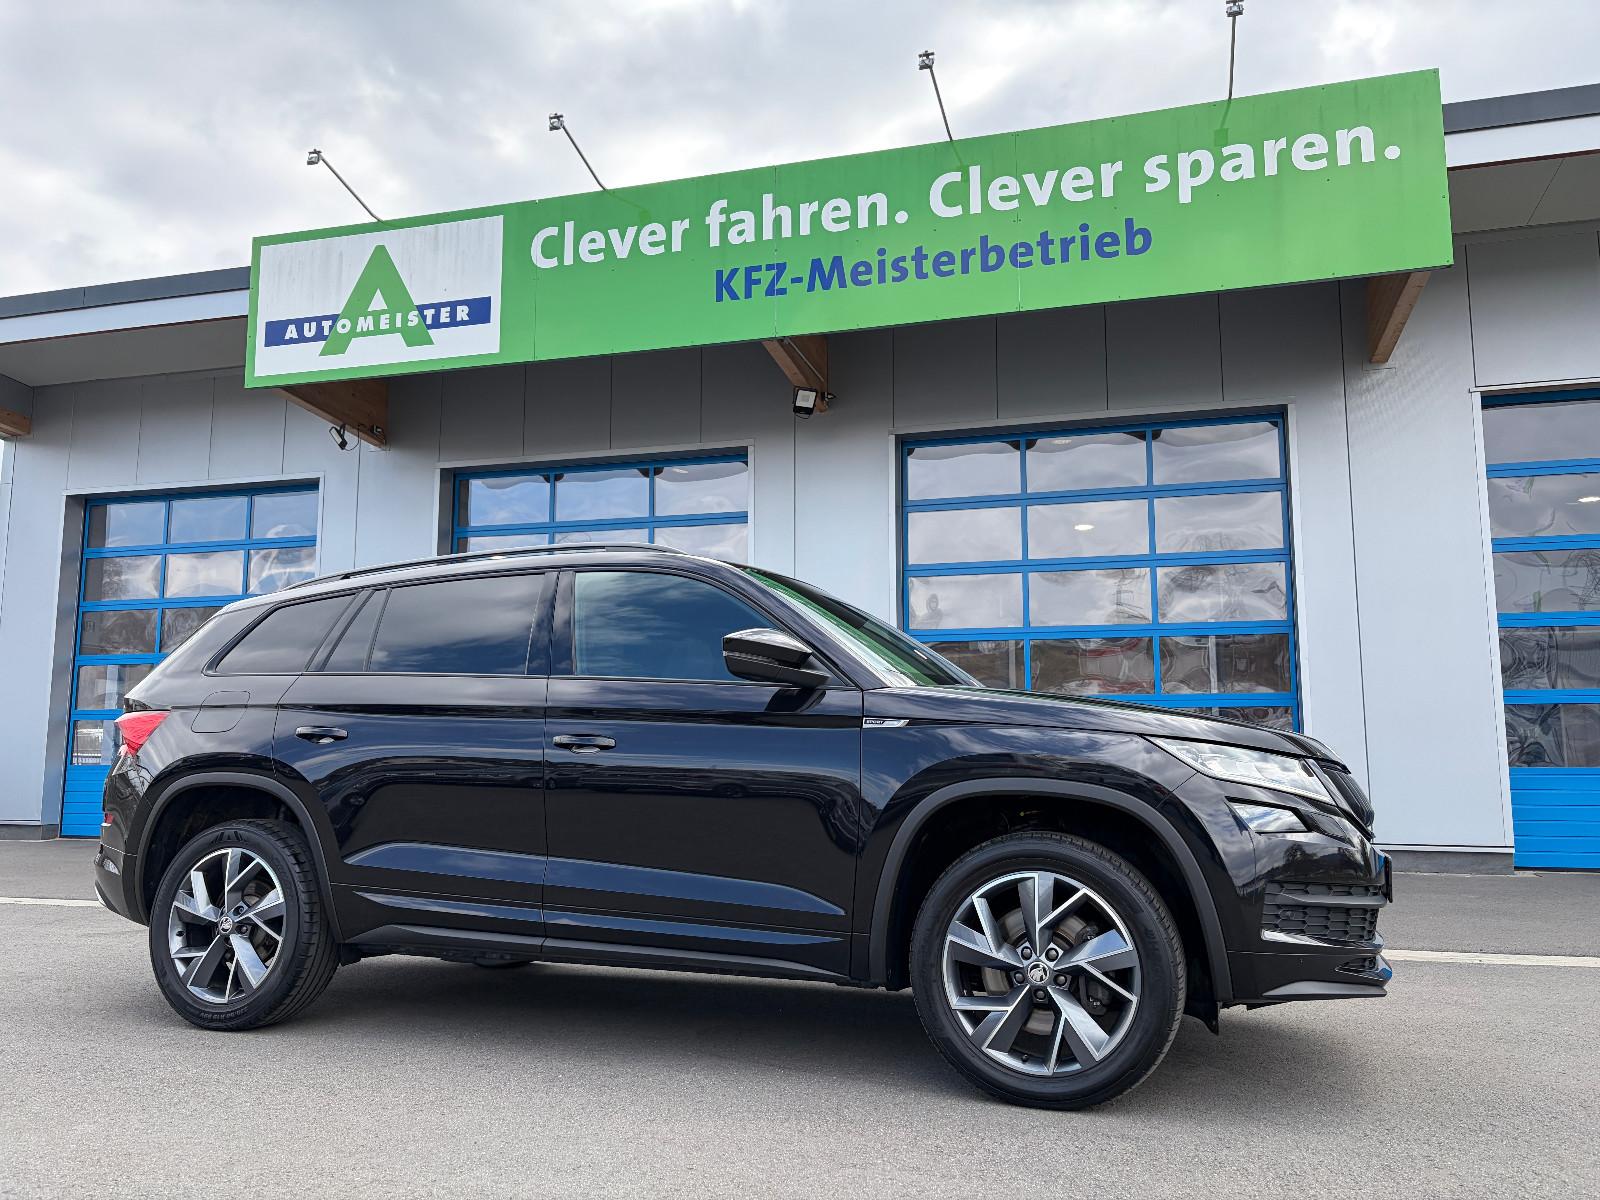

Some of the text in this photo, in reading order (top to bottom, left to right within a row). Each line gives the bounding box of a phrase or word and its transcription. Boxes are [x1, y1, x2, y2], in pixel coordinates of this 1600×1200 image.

[530, 123, 1403, 269] Clever fahren. Clever sparen.
[715, 218, 1153, 303] KFZ-Meisterbetrieb
[284, 304, 471, 340] AUTOMEISTER
